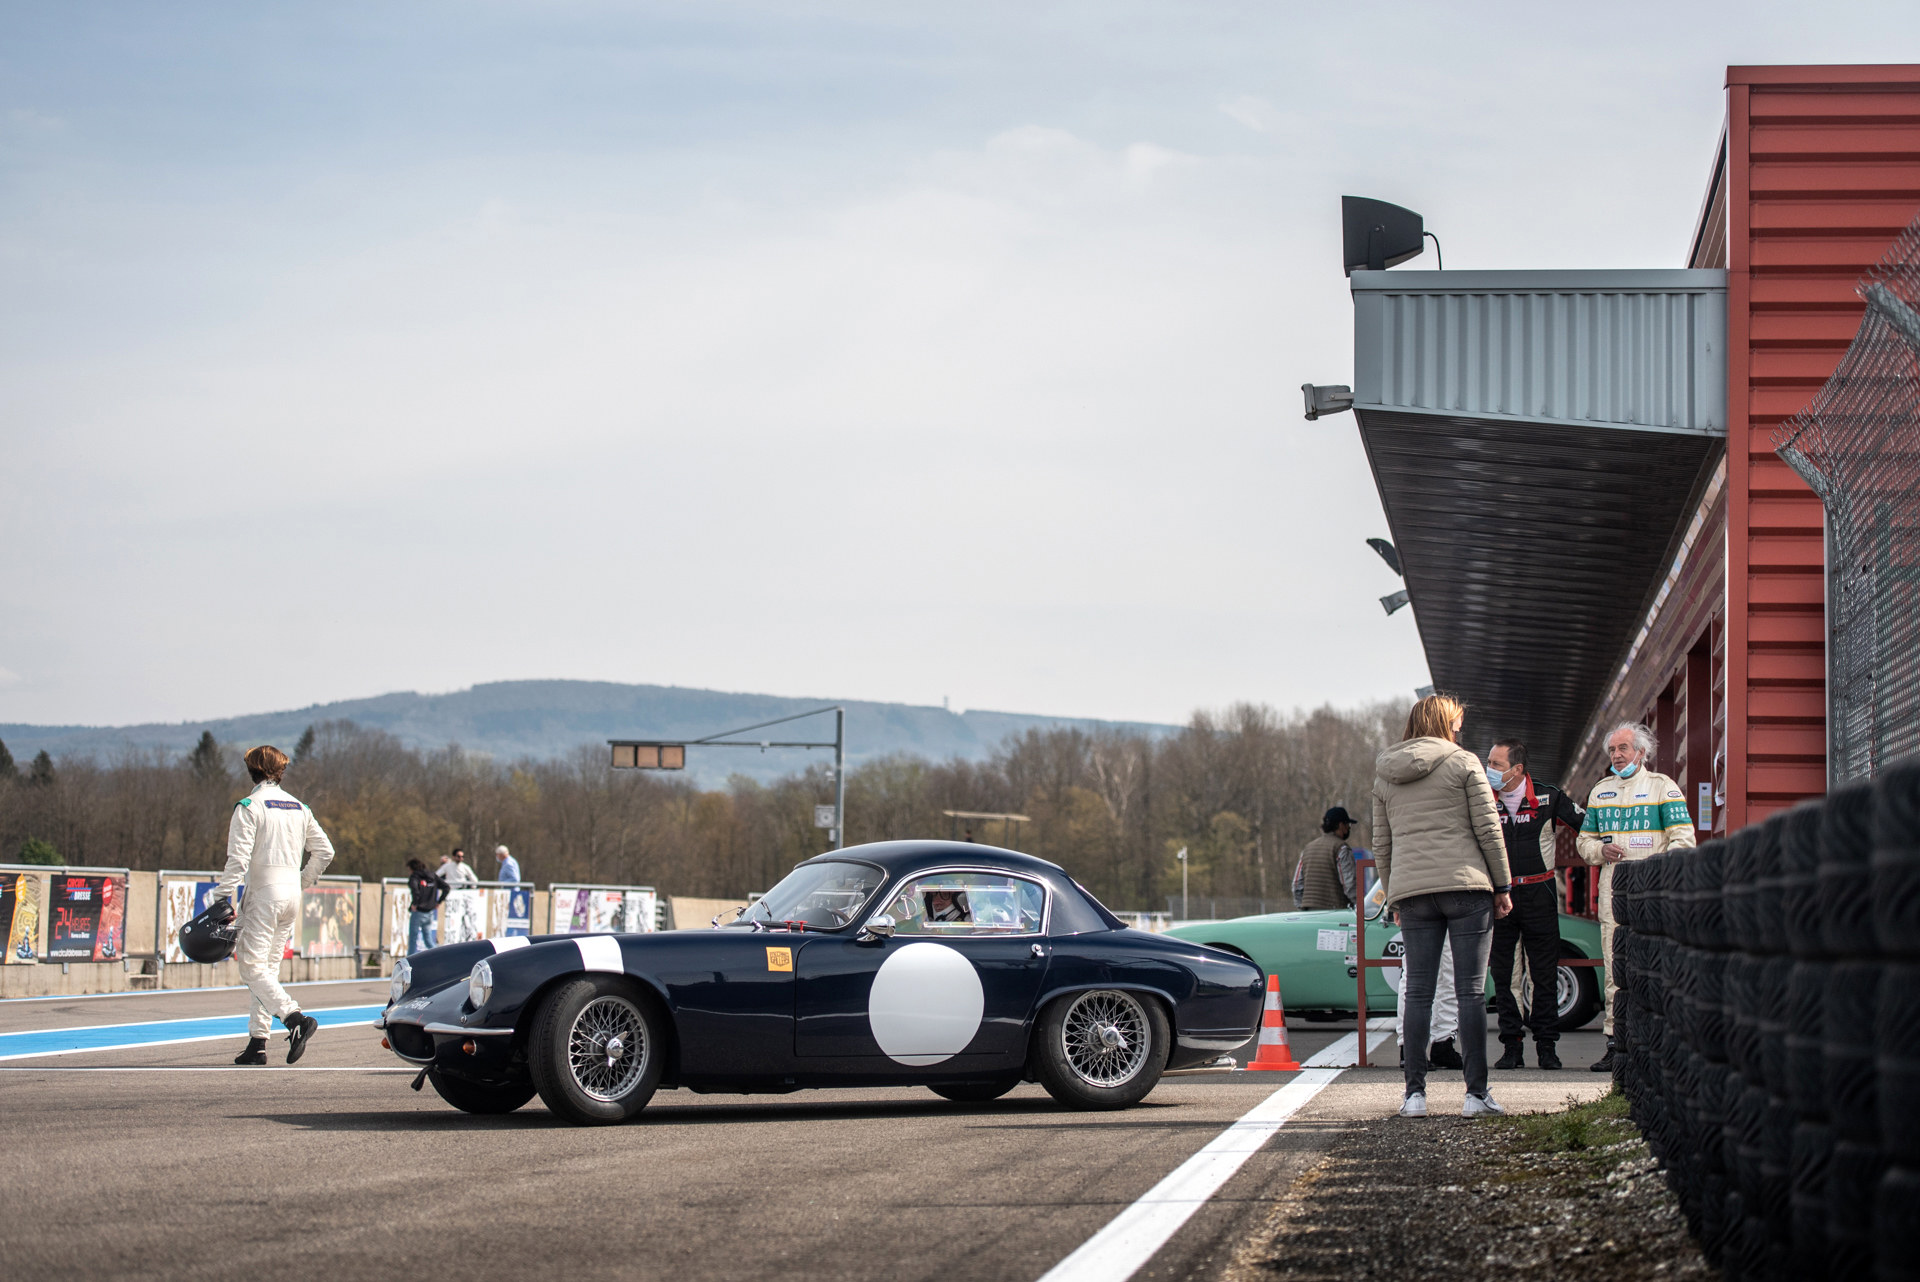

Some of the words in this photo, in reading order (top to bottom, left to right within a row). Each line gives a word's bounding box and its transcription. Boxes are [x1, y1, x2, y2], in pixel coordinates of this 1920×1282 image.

[1598, 806, 1649, 819] GROUPE
[1598, 819, 1650, 832] GAMAND
[74, 891, 91, 900] BRESSE
[55, 907, 72, 940] 24
